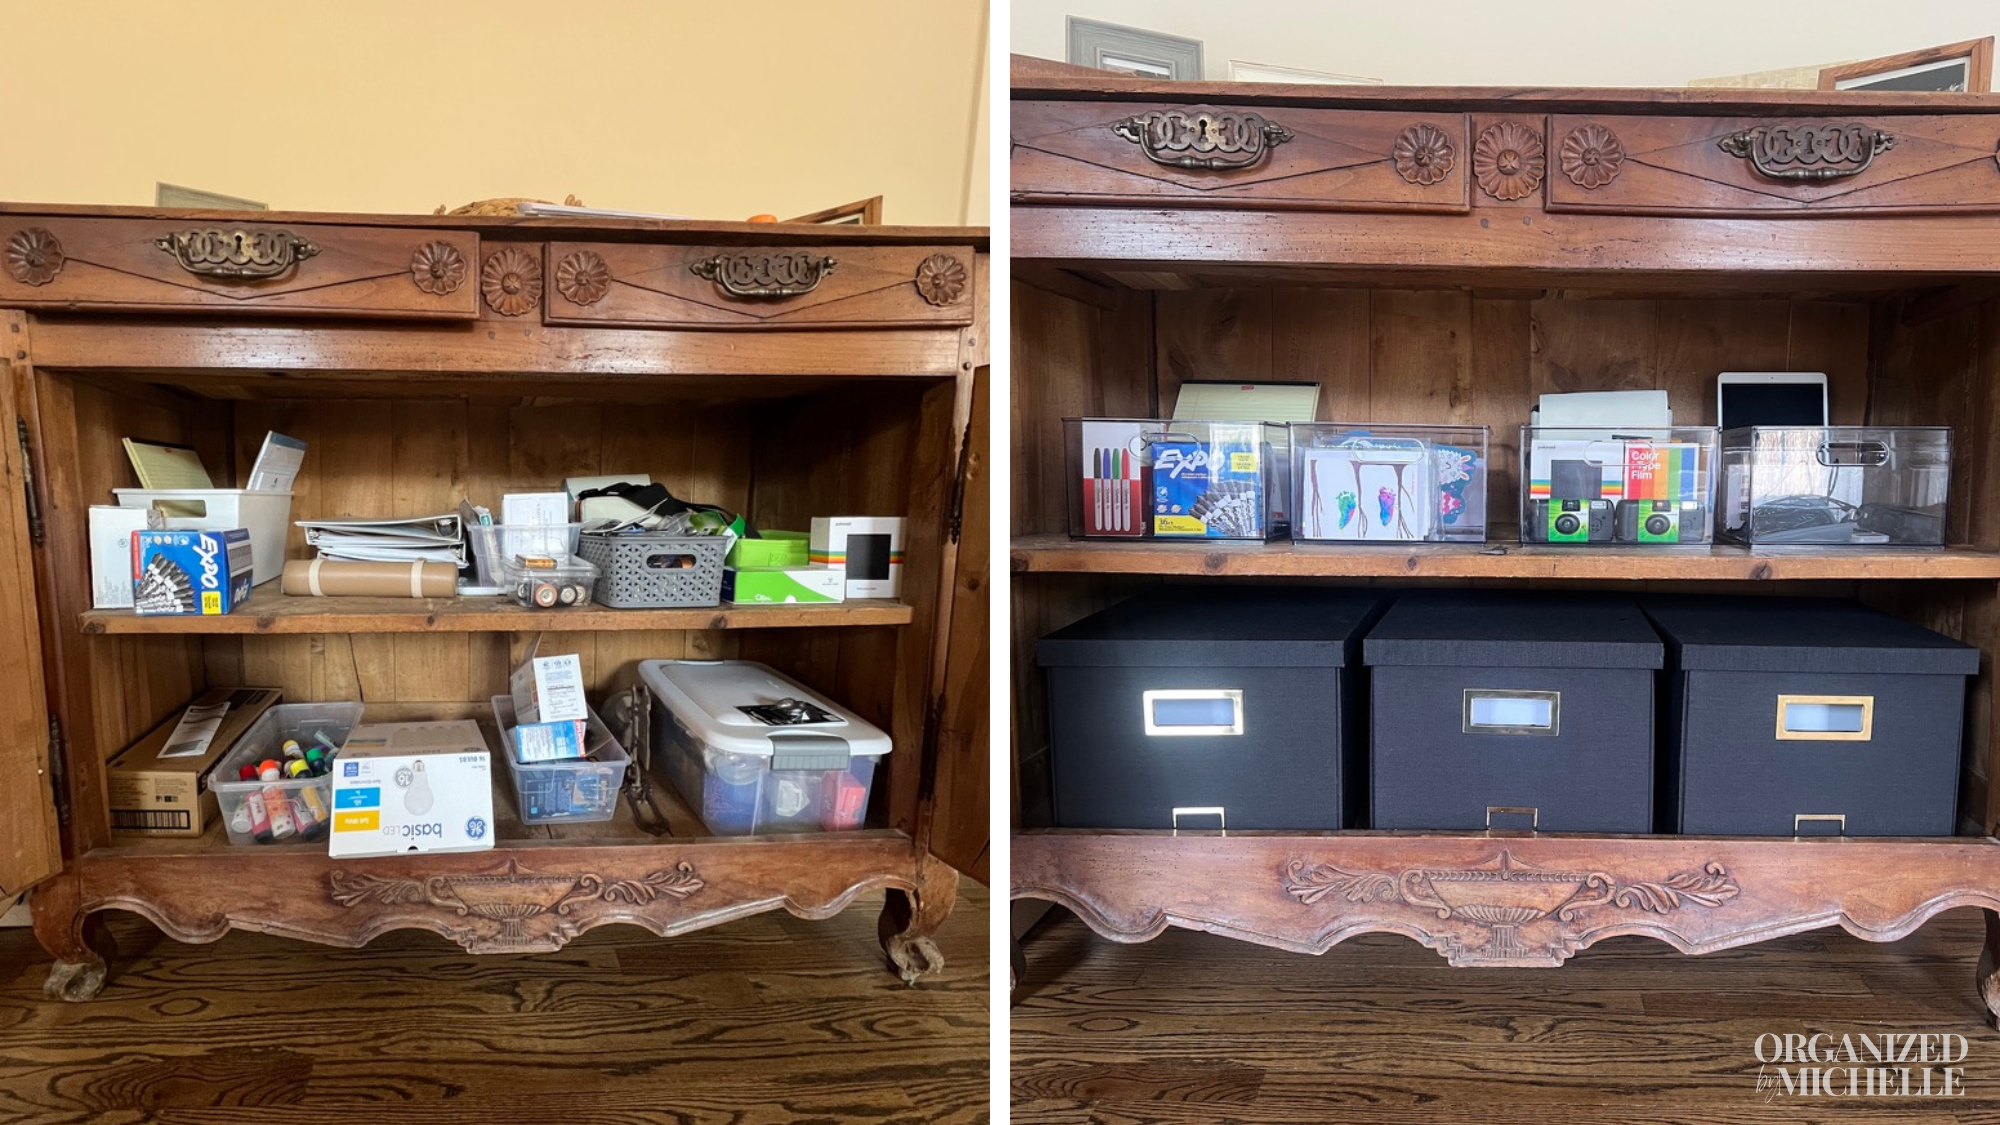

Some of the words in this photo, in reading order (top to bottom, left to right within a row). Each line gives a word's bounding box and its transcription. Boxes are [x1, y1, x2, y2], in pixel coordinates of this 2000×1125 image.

[1631, 450, 1659, 461] Color
[1154, 448, 1225, 479] EXPO
[1631, 470, 1653, 480] Film
[193, 533, 218, 588] EXPO
[398, 775, 411, 786] 16
[382, 825, 401, 836] LED
[401, 823, 442, 841] basic
